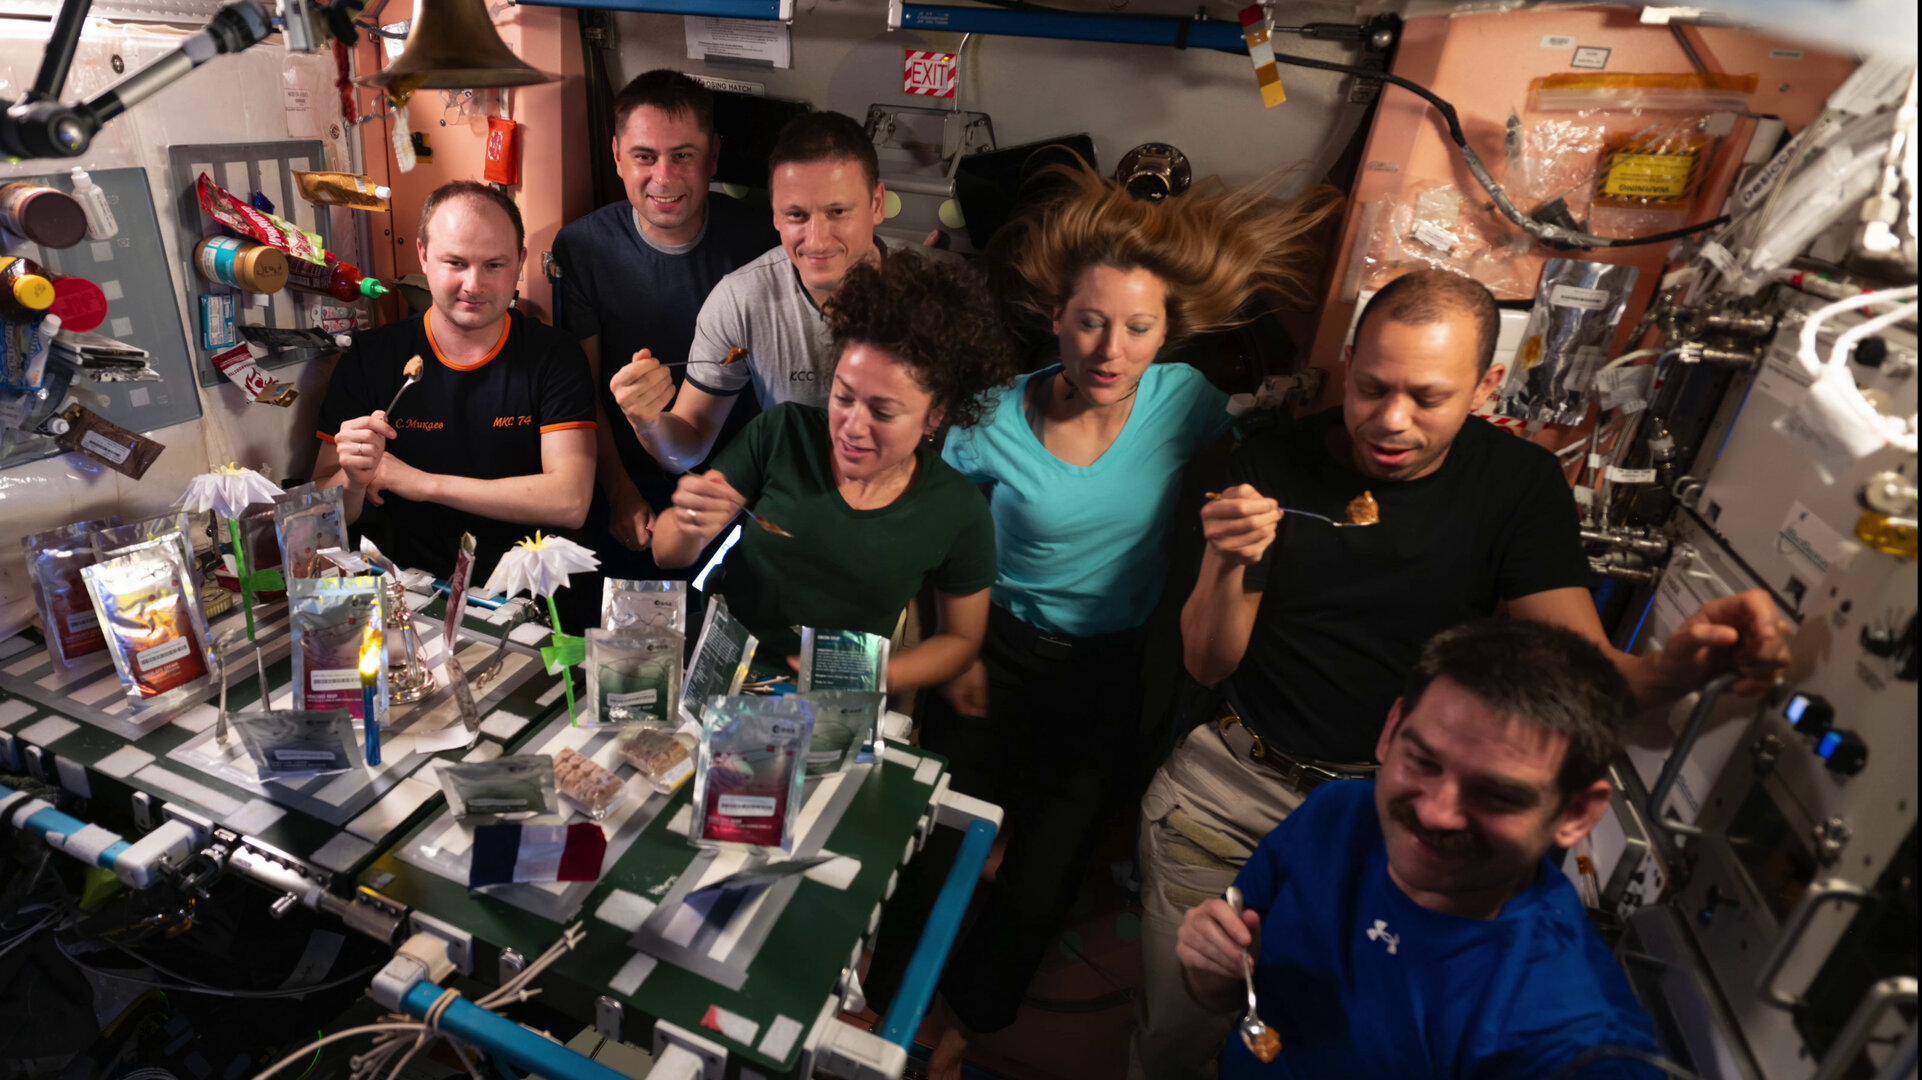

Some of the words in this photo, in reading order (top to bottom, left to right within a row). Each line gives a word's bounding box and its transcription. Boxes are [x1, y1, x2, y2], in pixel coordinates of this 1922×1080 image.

[912, 62, 948, 87] EXIT
[702, 80, 727, 90] OSING
[728, 84, 752, 93] HATCH
[517, 415, 532, 426] 74
